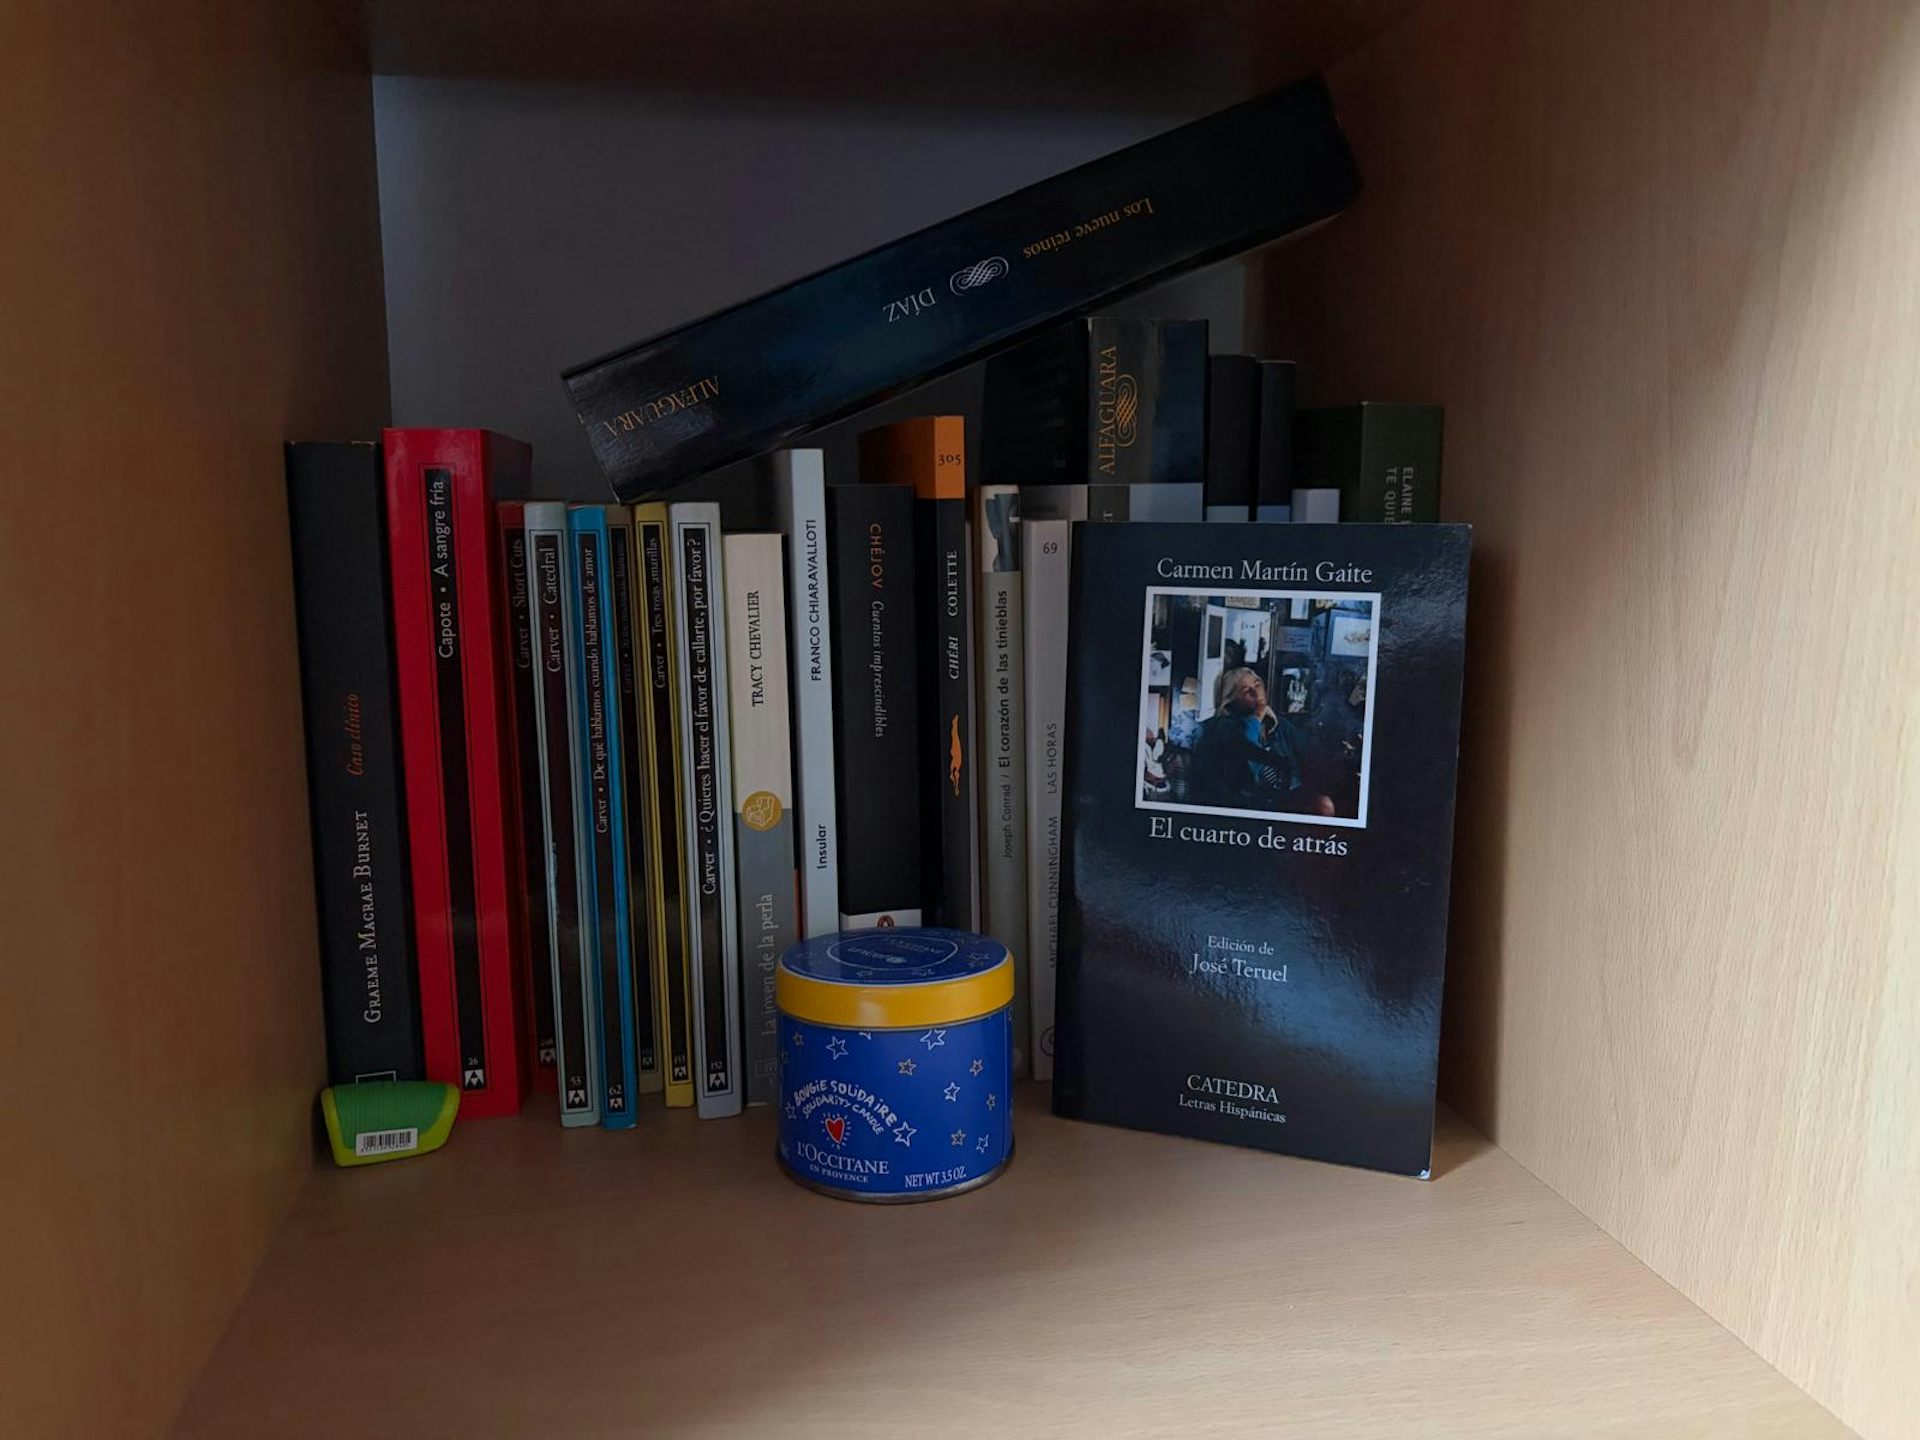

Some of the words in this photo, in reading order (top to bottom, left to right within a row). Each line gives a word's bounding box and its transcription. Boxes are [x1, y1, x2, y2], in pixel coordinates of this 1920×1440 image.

[1075, 211, 1121, 238] nueve
[1124, 197, 1154, 217] Los
[1022, 230, 1072, 259] reinos
[882, 287, 938, 323] DÍAZ
[603, 375, 720, 438] ALFAGUARA
[1099, 345, 1117, 475] ALFAGUARA
[938, 454, 962, 467] 305
[1385, 466, 1398, 485] TE
[430, 480, 445, 506] fría
[1401, 466, 1414, 515] ELAINE
[434, 510, 451, 560] sangre
[1043, 542, 1058, 554] 69
[433, 562, 450, 579] A
[584, 548, 595, 577] amor
[806, 519, 820, 624] CHIARAVALLOTI
[868, 522, 886, 590] CHÉJOV
[1156, 557, 1234, 581] Carmen
[1239, 558, 1309, 583] Martín
[1315, 560, 1374, 584] Gaite
[511, 572, 527, 608] Short
[539, 547, 558, 605] Catedral
[583, 580, 595, 594] de
[947, 549, 960, 617] COLETTE
[693, 585, 708, 609] por
[438, 602, 458, 659] Capote
[584, 596, 599, 646] hablamos
[652, 614, 664, 634] Tres
[747, 590, 762, 661] CHEVALIER
[871, 600, 885, 646] Cuentos
[995, 590, 1008, 649] tinieblas
[517, 626, 531, 669] Carver
[546, 626, 562, 673] Carver
[812, 627, 822, 681] FRANCO
[996, 654, 1008, 672] las
[586, 648, 601, 687] cuando
[655, 654, 667, 689] Carver
[691, 665, 707, 683] de
[693, 686, 708, 720] favor
[752, 664, 765, 707] TRACY
[870, 648, 888, 738] imprescindibles
[997, 677, 1009, 694] de
[590, 689, 604, 739] hablamos
[694, 722, 709, 732] el
[997, 699, 1010, 752] corazón
[346, 743, 364, 777] Caso
[696, 736, 711, 770] hacer
[998, 756, 1010, 768] El
[1047, 722, 1058, 768] HORAS
[594, 763, 605, 780] De
[1048, 771, 1058, 794] LAS
[596, 798, 609, 834] Carver
[699, 773, 715, 833] ¿Quieres
[1002, 784, 1012, 822] Conrad
[354, 809, 372, 879] BURNET
[816, 823, 827, 869] Insular
[1003, 823, 1014, 858] Joseph
[1149, 816, 1173, 839] El
[1179, 825, 1251, 847] cuarto
[1257, 826, 1287, 850] de
[1292, 834, 1349, 857] atrás
[702, 852, 716, 894] Carver
[1048, 816, 1058, 909] CUNNINGHAM
[357, 883, 377, 951] MACRAE
[756, 893, 779, 932] perla
[757, 934, 775, 949] la
[1207, 935, 1255, 954] Edición
[1258, 941, 1275, 956] de
[758, 951, 775, 973] de
[1189, 953, 1228, 975] José
[1231, 958, 1288, 983] Teruel
[363, 953, 382, 1024] GRAEME
[608, 1084, 622, 1096] 62
[1187, 1074, 1280, 1104] CATEDRA
[852, 1103, 885, 1136] CANDLE
[1179, 1093, 1217, 1112] Letras
[1220, 1100, 1287, 1124] Hispánicas
[797, 1141, 890, 1175] L'OCCITANE
[821, 1168, 870, 1184] PROVENCE
[904, 1172, 923, 1188] NET
[924, 1171, 940, 1186] WT
